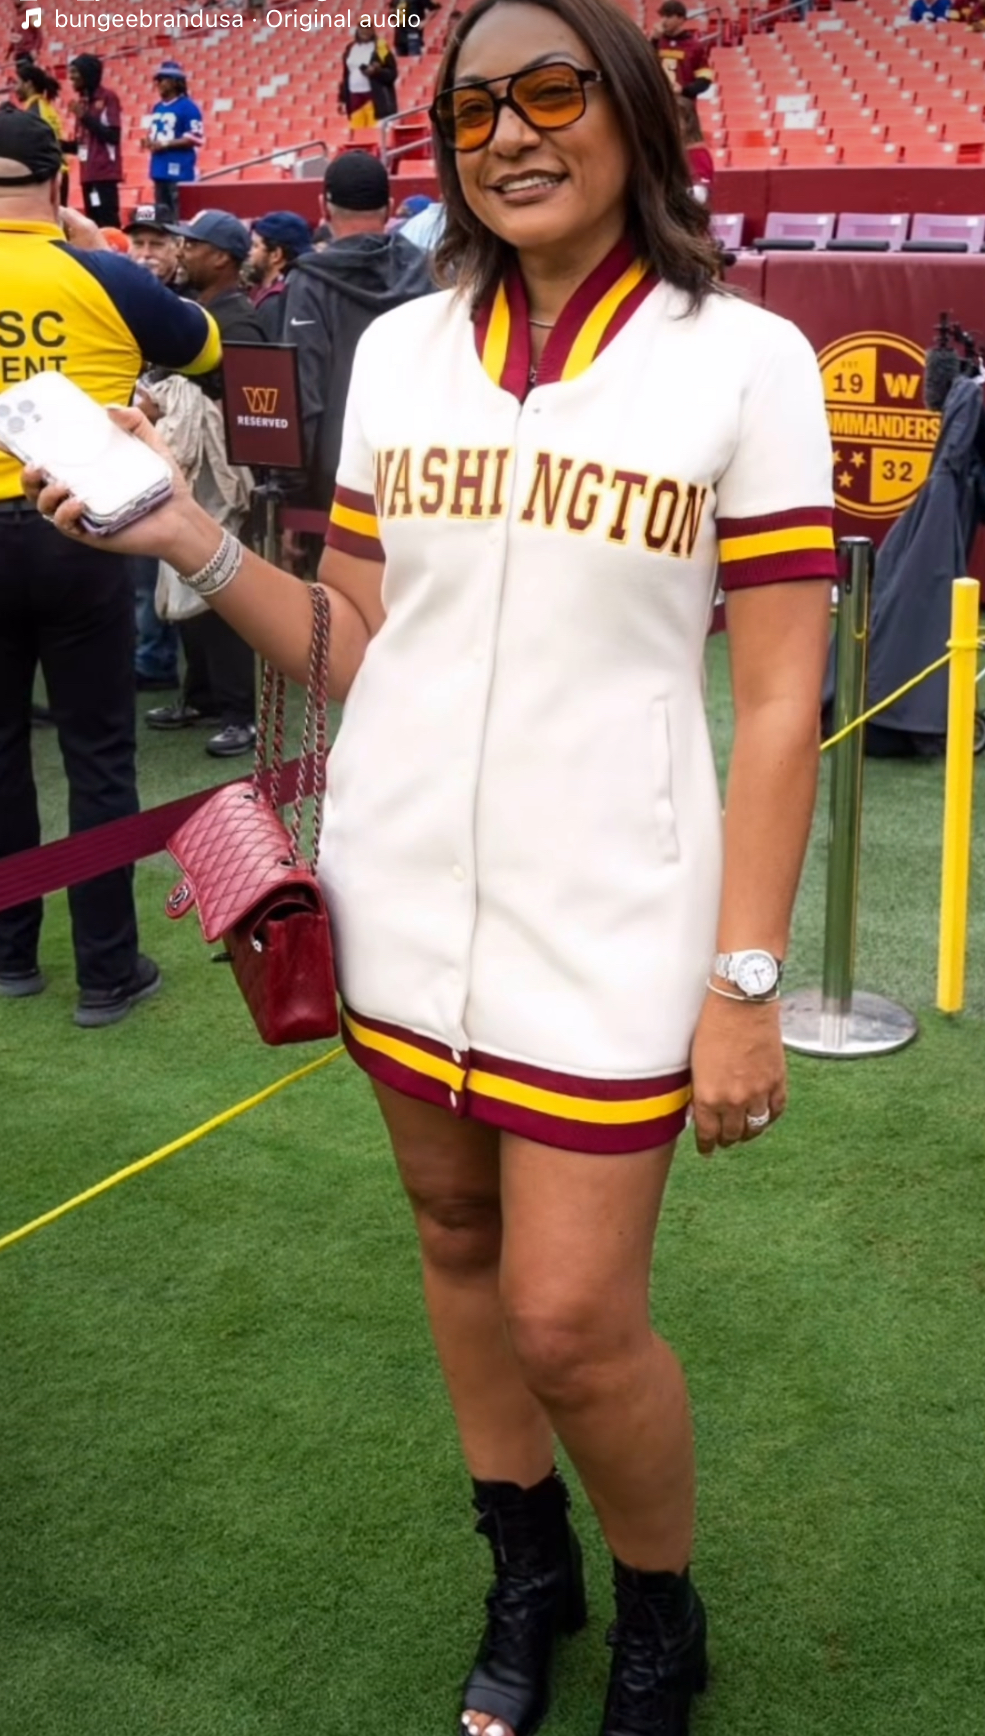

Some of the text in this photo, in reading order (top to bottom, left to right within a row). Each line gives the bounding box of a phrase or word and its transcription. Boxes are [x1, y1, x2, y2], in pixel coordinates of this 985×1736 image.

[833, 373, 864, 395] 19
[236, 415, 289, 430] RESERVED
[882, 459, 913, 483] 32
[372, 446, 708, 559] WASHINGTON
